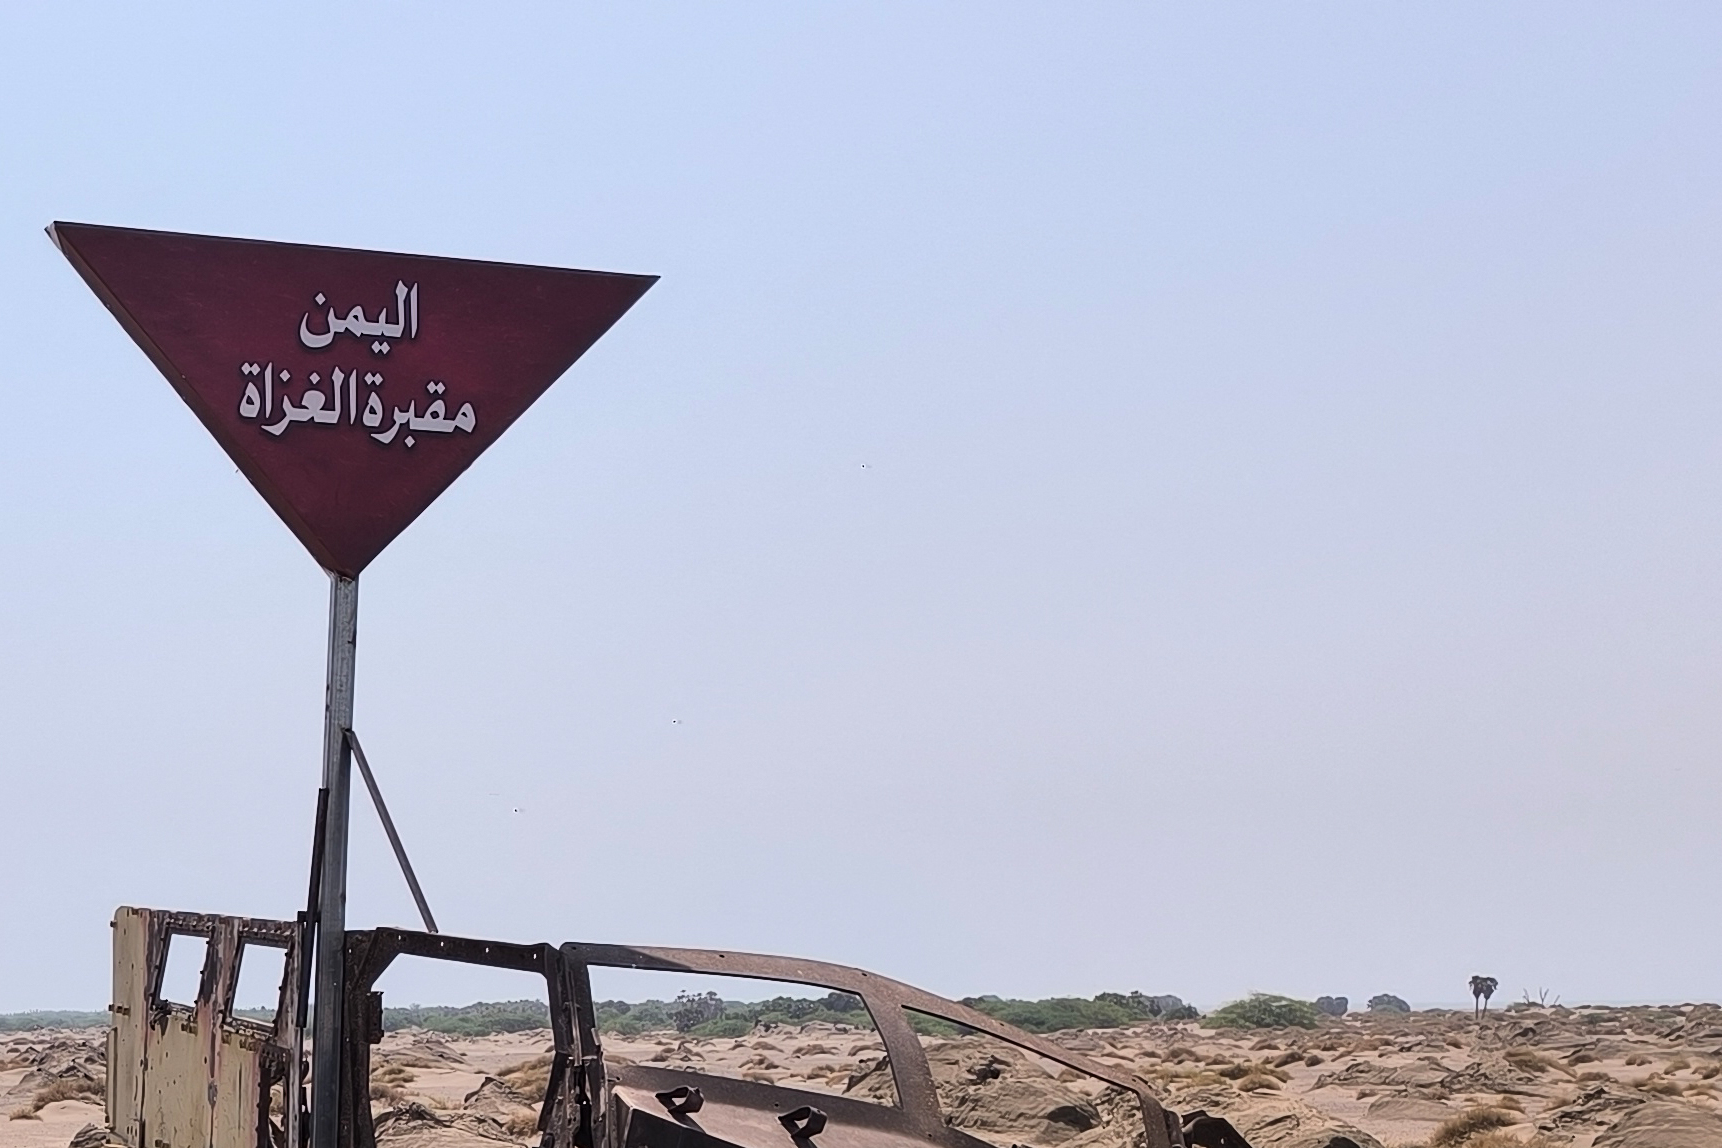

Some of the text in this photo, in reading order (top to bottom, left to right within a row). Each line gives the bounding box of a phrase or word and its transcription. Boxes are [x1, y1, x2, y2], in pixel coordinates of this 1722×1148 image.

[300, 280, 418, 354] اليمن
[240, 363, 476, 448] مقبرة الغزاة
